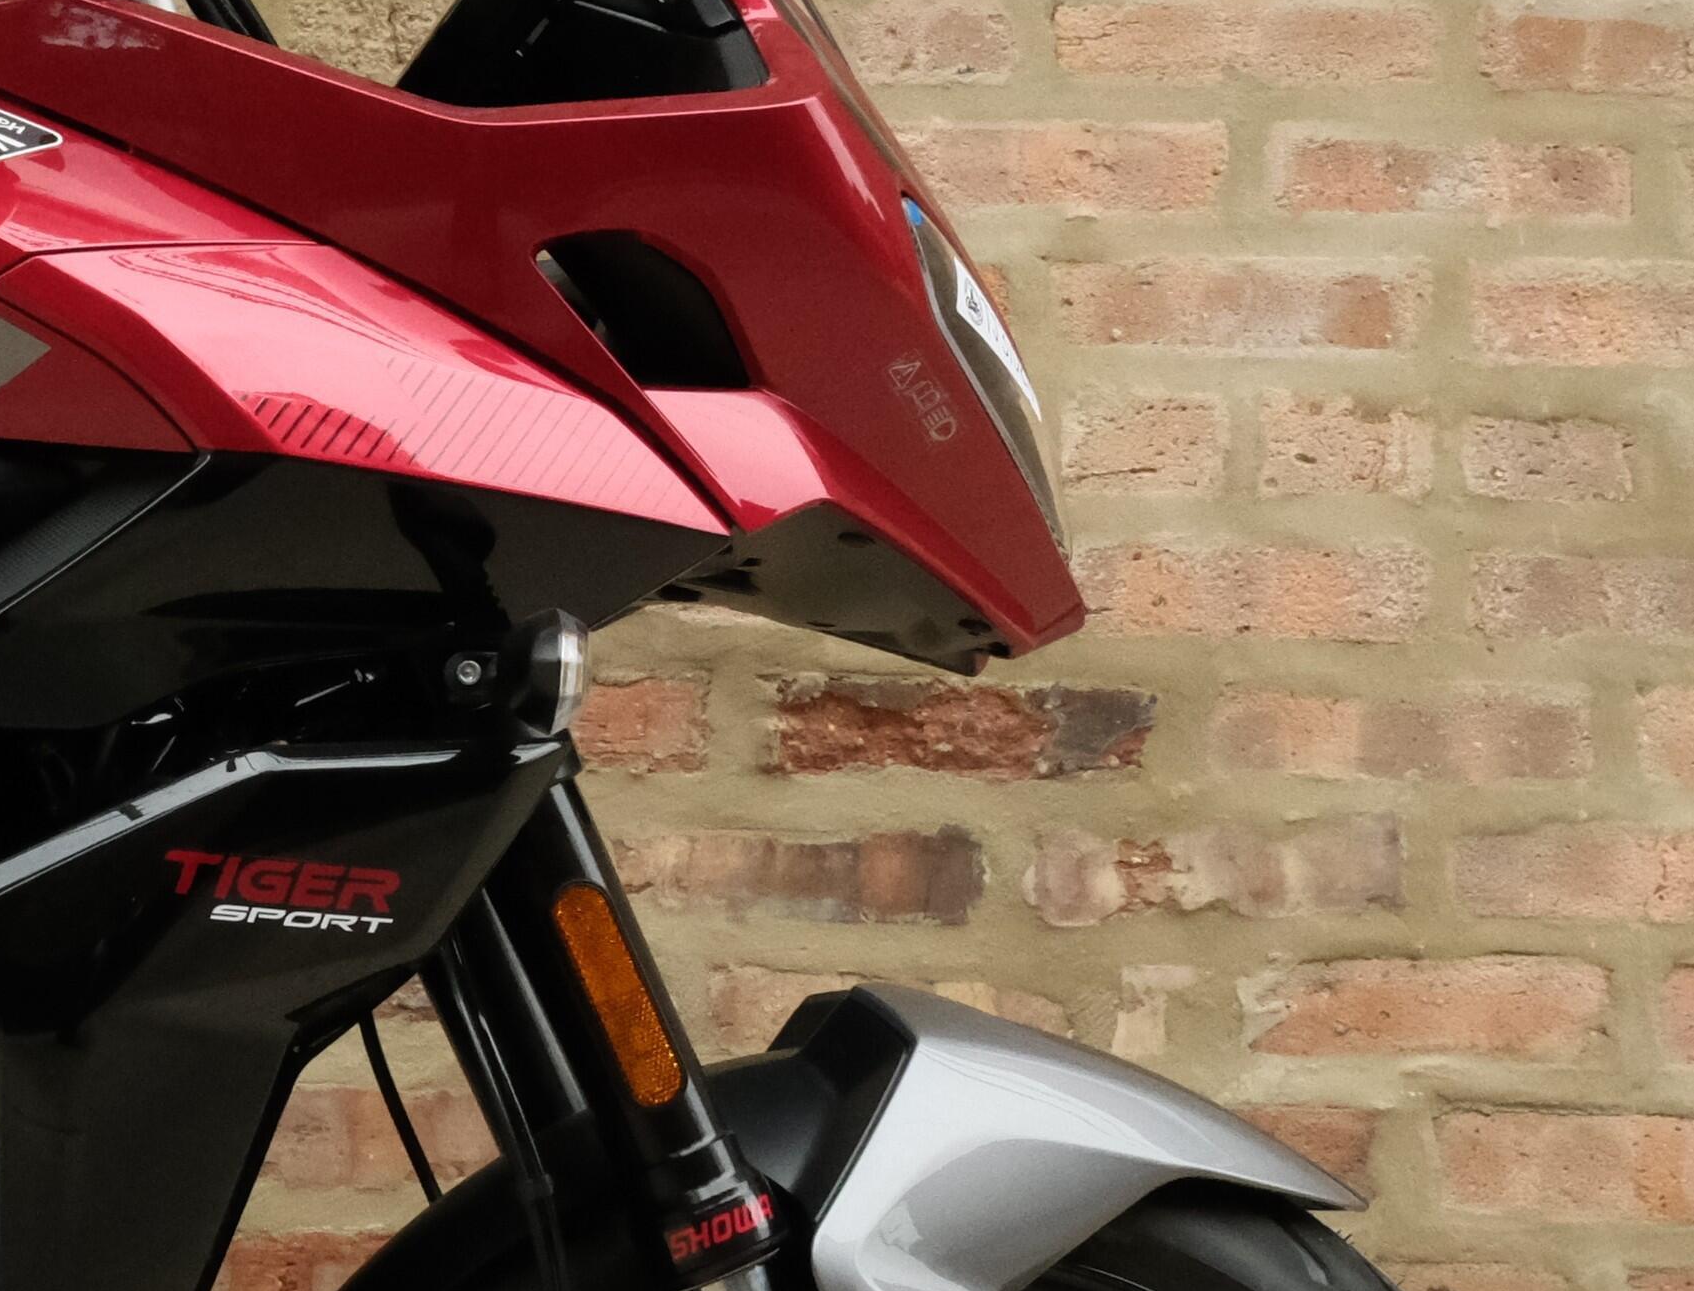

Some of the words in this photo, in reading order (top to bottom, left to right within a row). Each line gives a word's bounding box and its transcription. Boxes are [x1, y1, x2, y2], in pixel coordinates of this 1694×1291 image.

[165, 850, 401, 912] TIGER
[210, 904, 393, 933] SPORT
[666, 1194, 773, 1261] SHOWA
